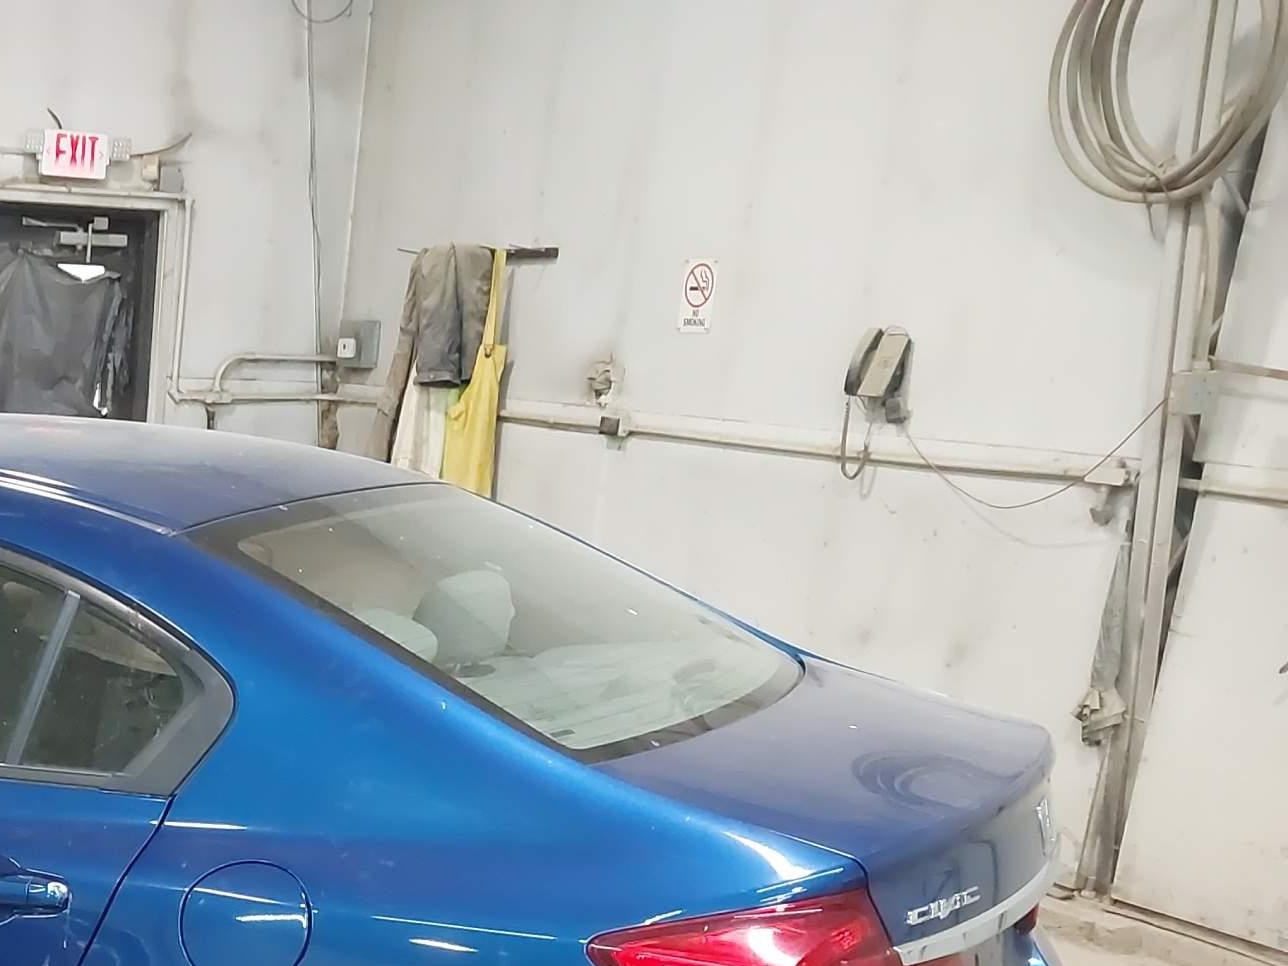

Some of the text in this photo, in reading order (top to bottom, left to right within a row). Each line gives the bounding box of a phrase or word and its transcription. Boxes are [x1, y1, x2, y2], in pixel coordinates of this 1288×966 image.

[55, 132, 100, 169] EXIT
[692, 309, 700, 318] NO
[683, 318, 706, 327] SMOKING
